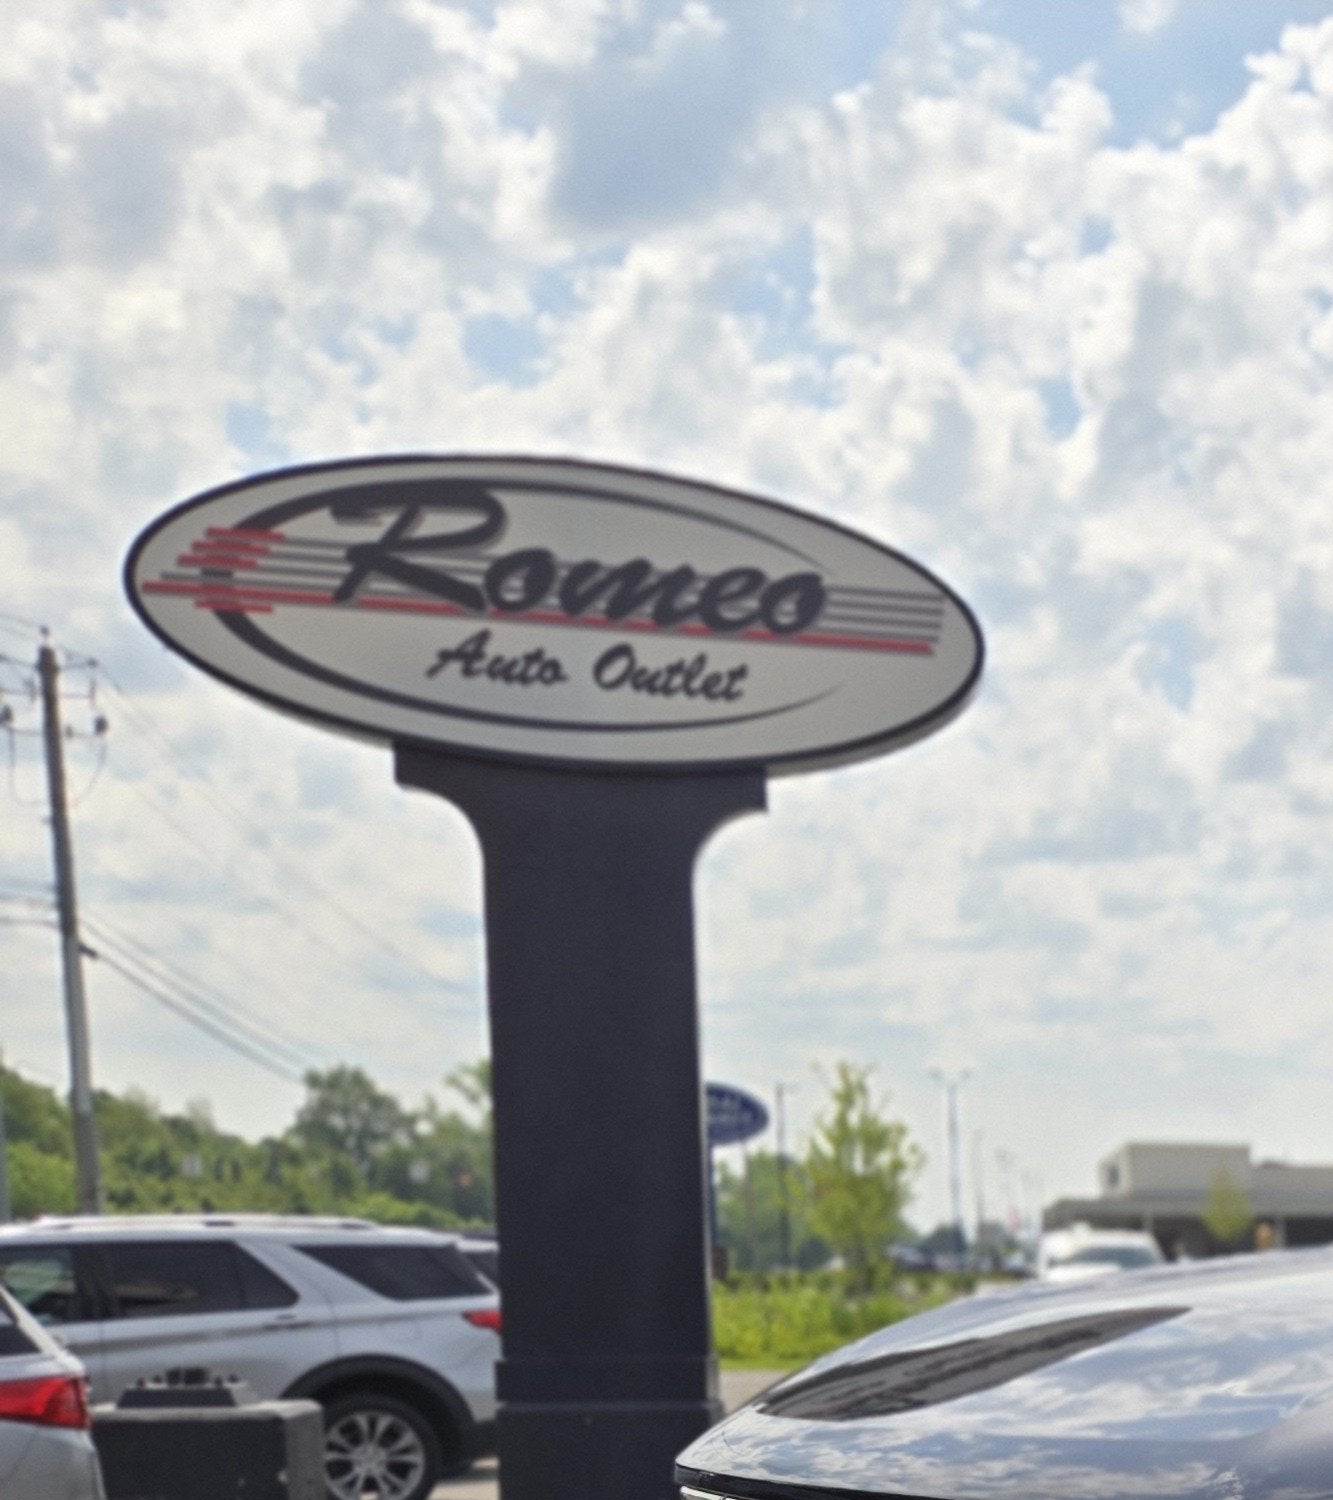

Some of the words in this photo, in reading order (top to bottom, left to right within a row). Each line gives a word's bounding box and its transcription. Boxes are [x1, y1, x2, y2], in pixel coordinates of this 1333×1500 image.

[326, 481, 827, 634] Romeo
[425, 628, 567, 686] Auto
[593, 642, 747, 702] Outlet
